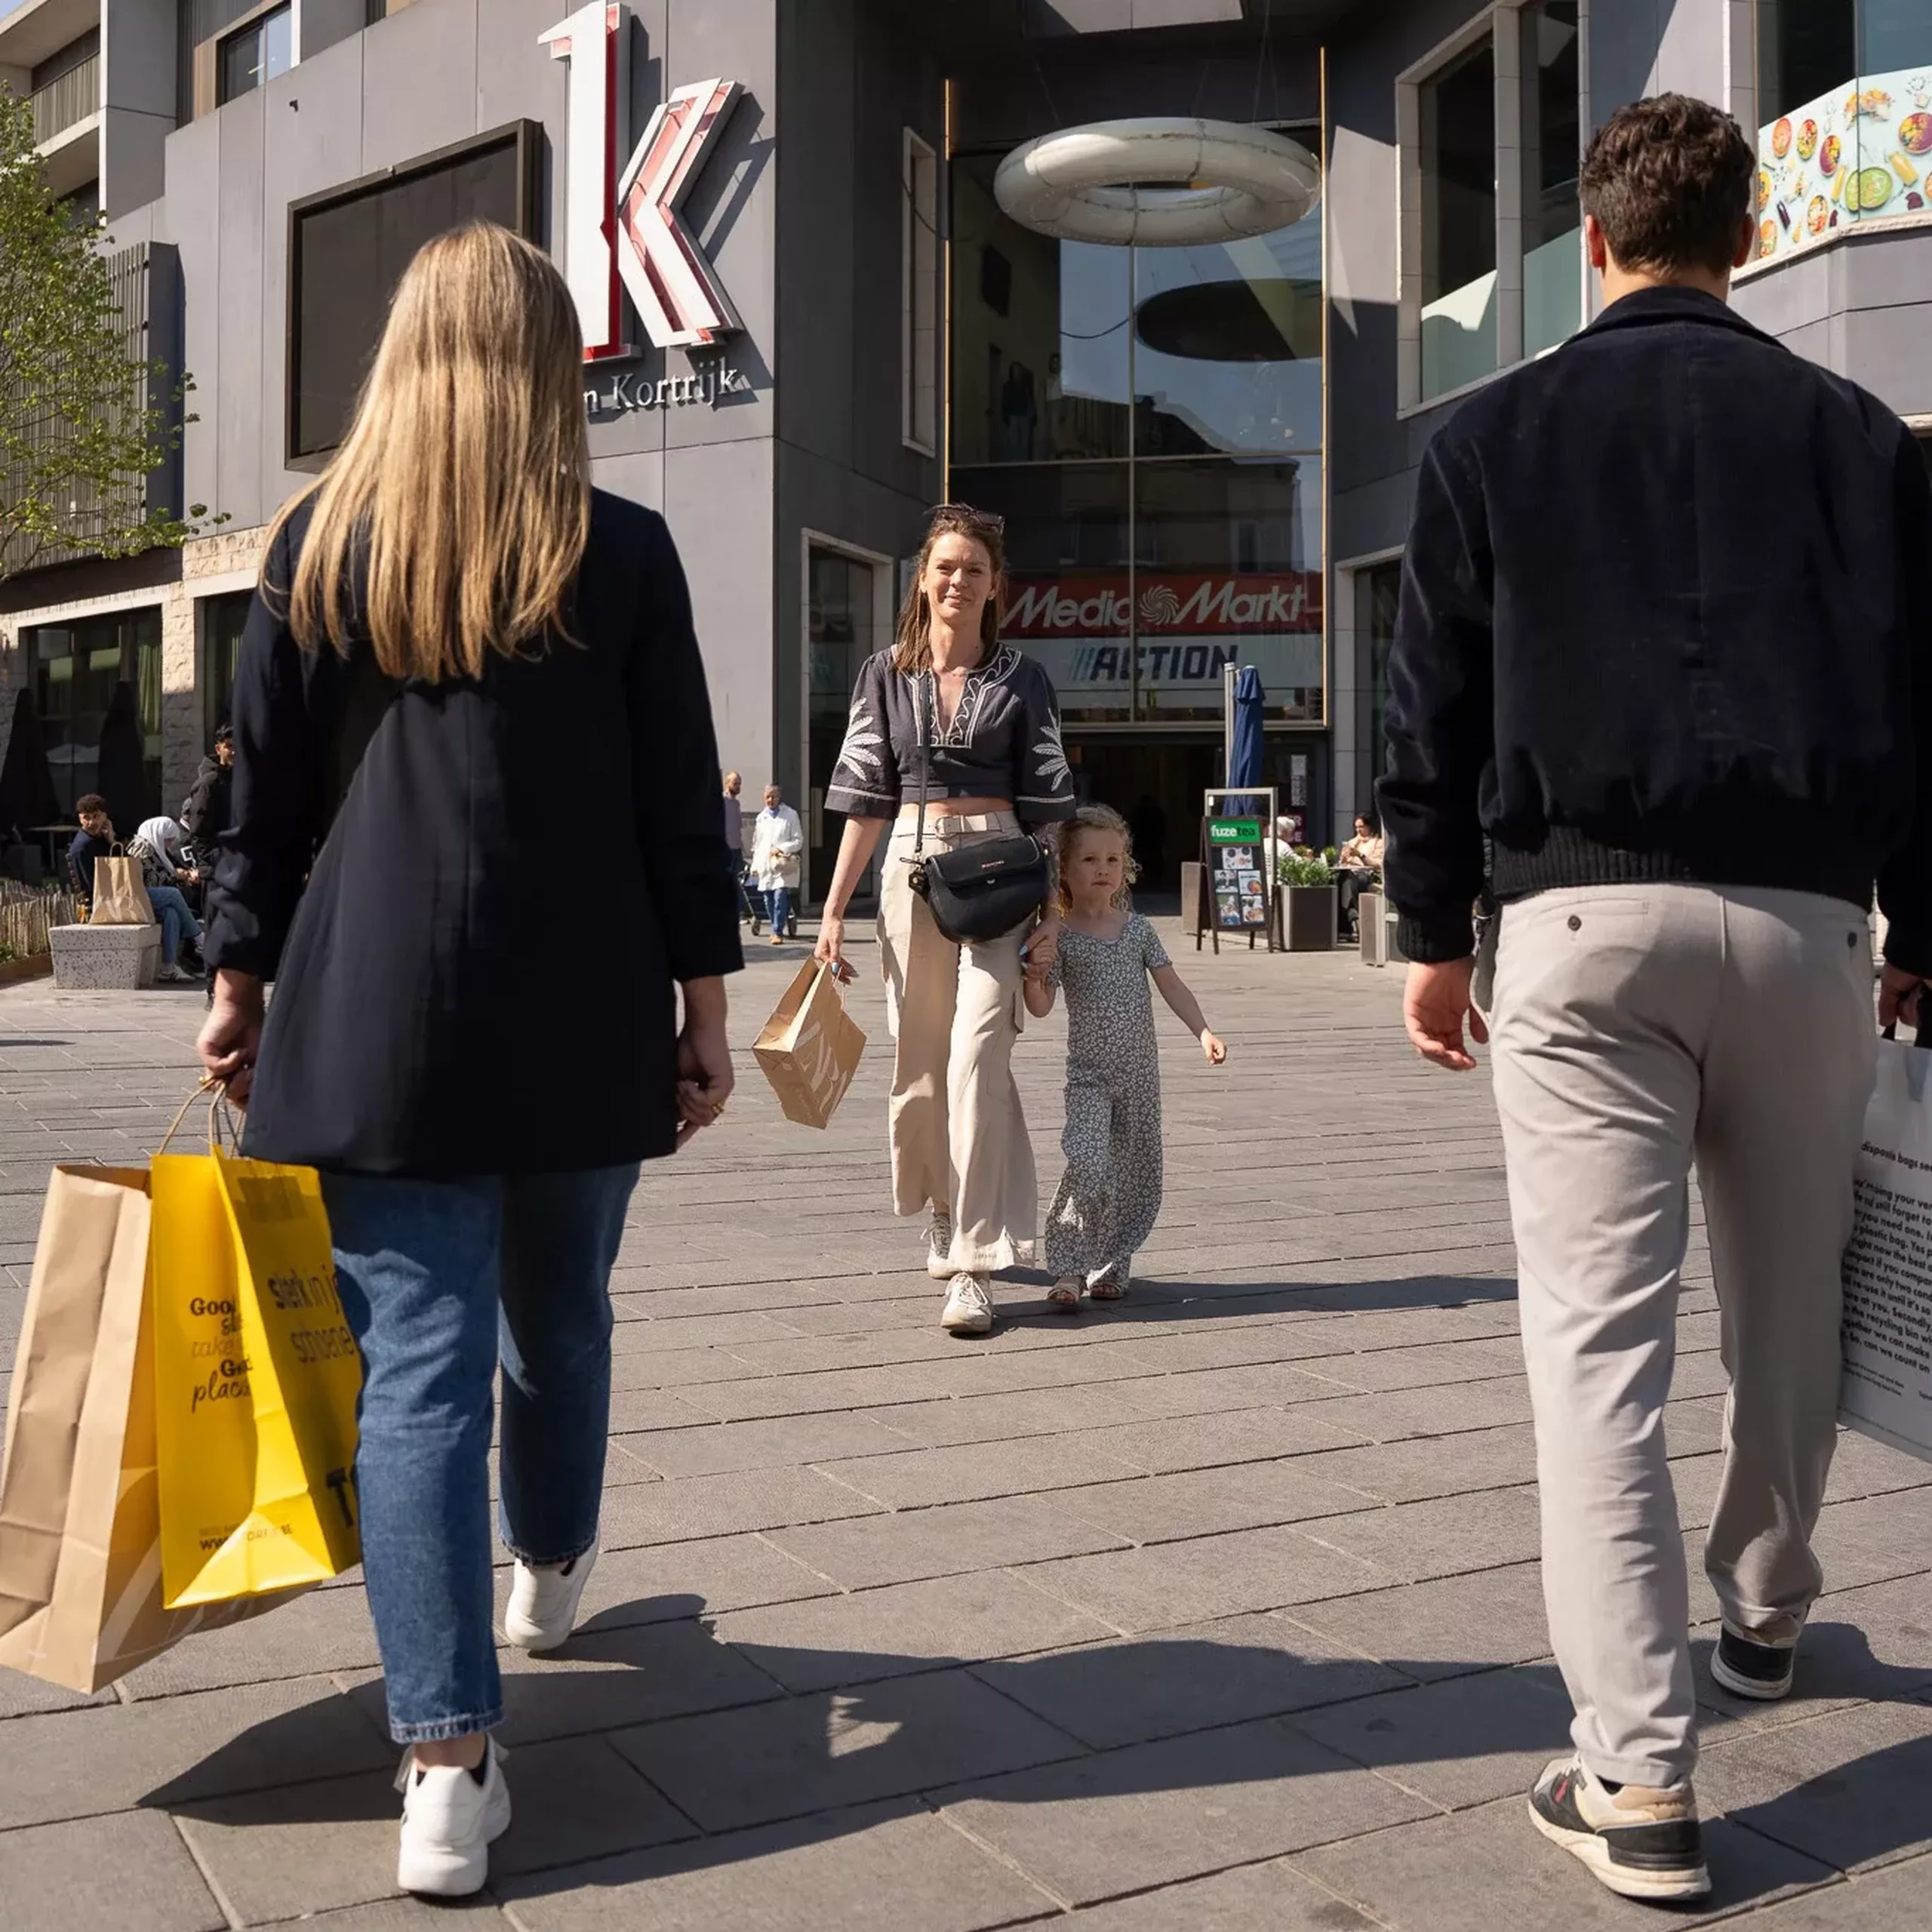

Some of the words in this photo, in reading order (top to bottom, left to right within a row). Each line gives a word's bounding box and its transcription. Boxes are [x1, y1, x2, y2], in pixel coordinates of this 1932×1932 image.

[583, 389, 599, 413] n
[612, 356, 737, 411] Kortrijk
[1171, 580, 1307, 625] Markt
[1089, 645, 1238, 681] ACTION
[1894, 1192, 1915, 1205] your
